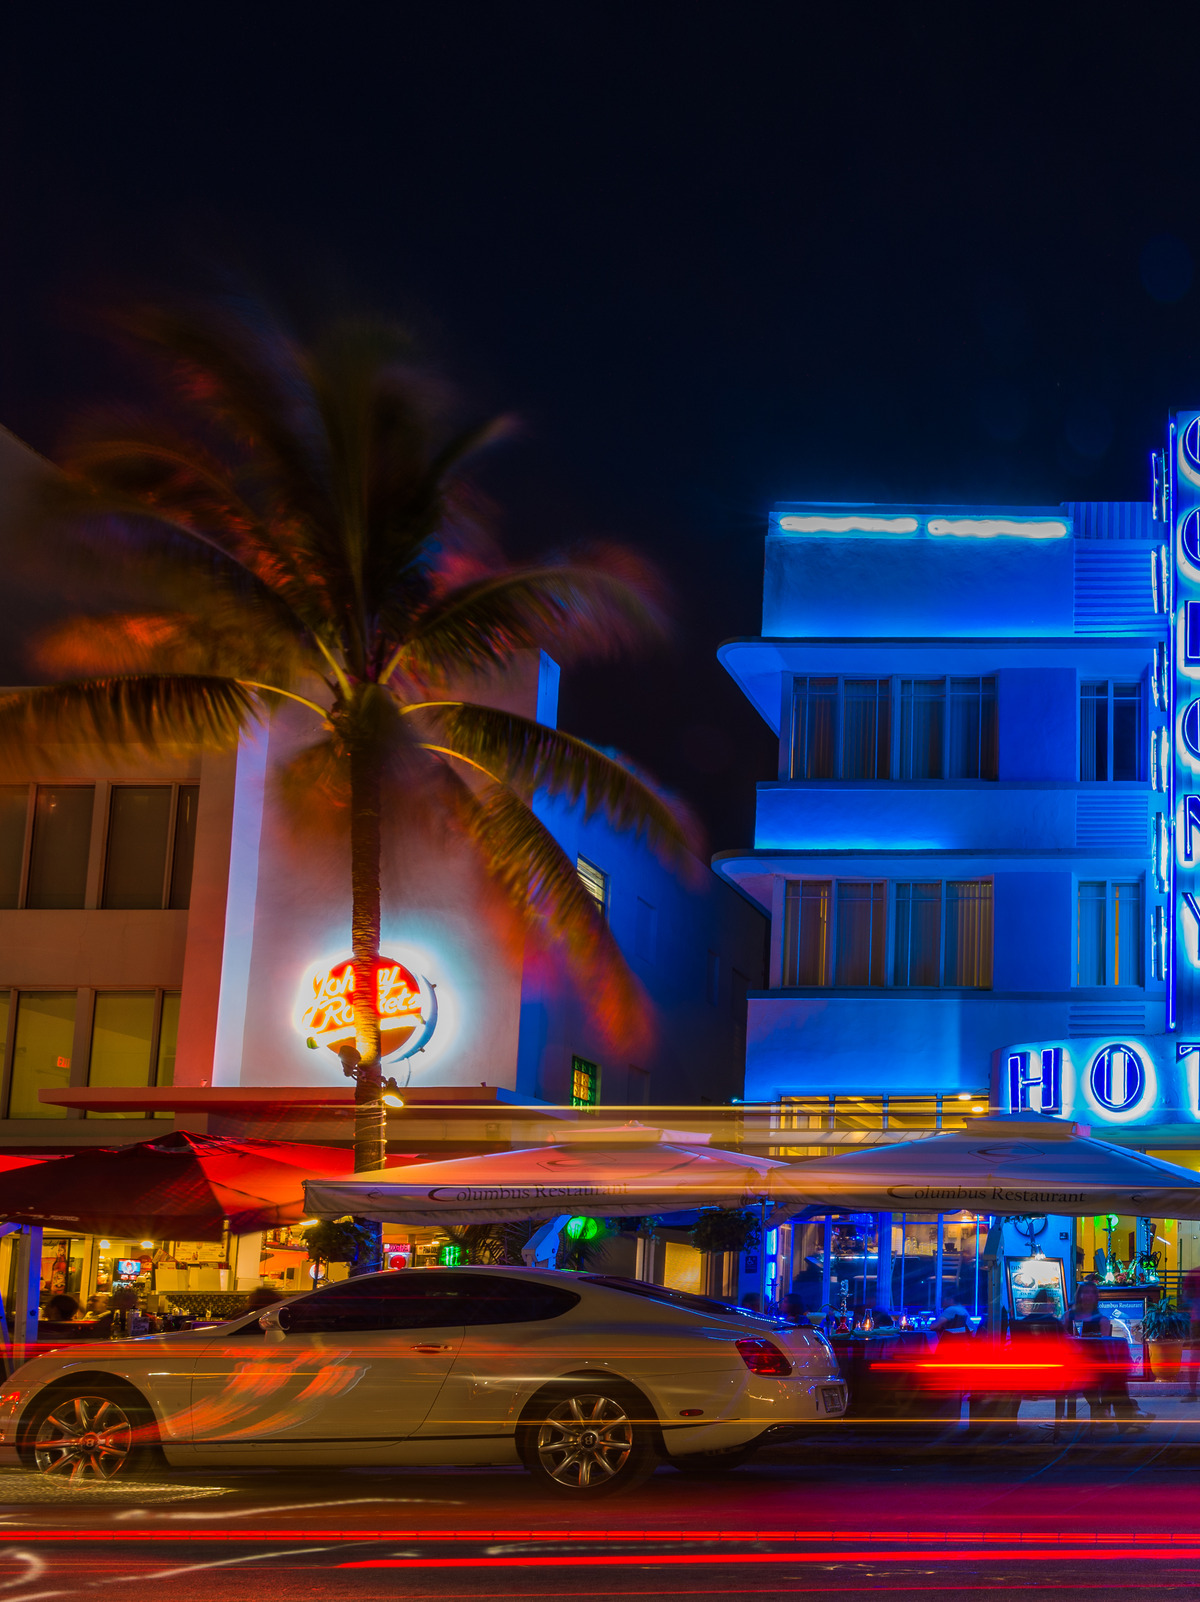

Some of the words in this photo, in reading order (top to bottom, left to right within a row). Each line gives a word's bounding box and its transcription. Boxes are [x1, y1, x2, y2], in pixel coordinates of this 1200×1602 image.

[302, 964, 406, 1022] Johy
[315, 987, 422, 1031] Roets
[427, 1184, 530, 1202] Columbus
[534, 1182, 629, 1199] Restaurant
[887, 1184, 986, 1200] Columbus
[991, 1186, 1087, 1202] Restaurant
